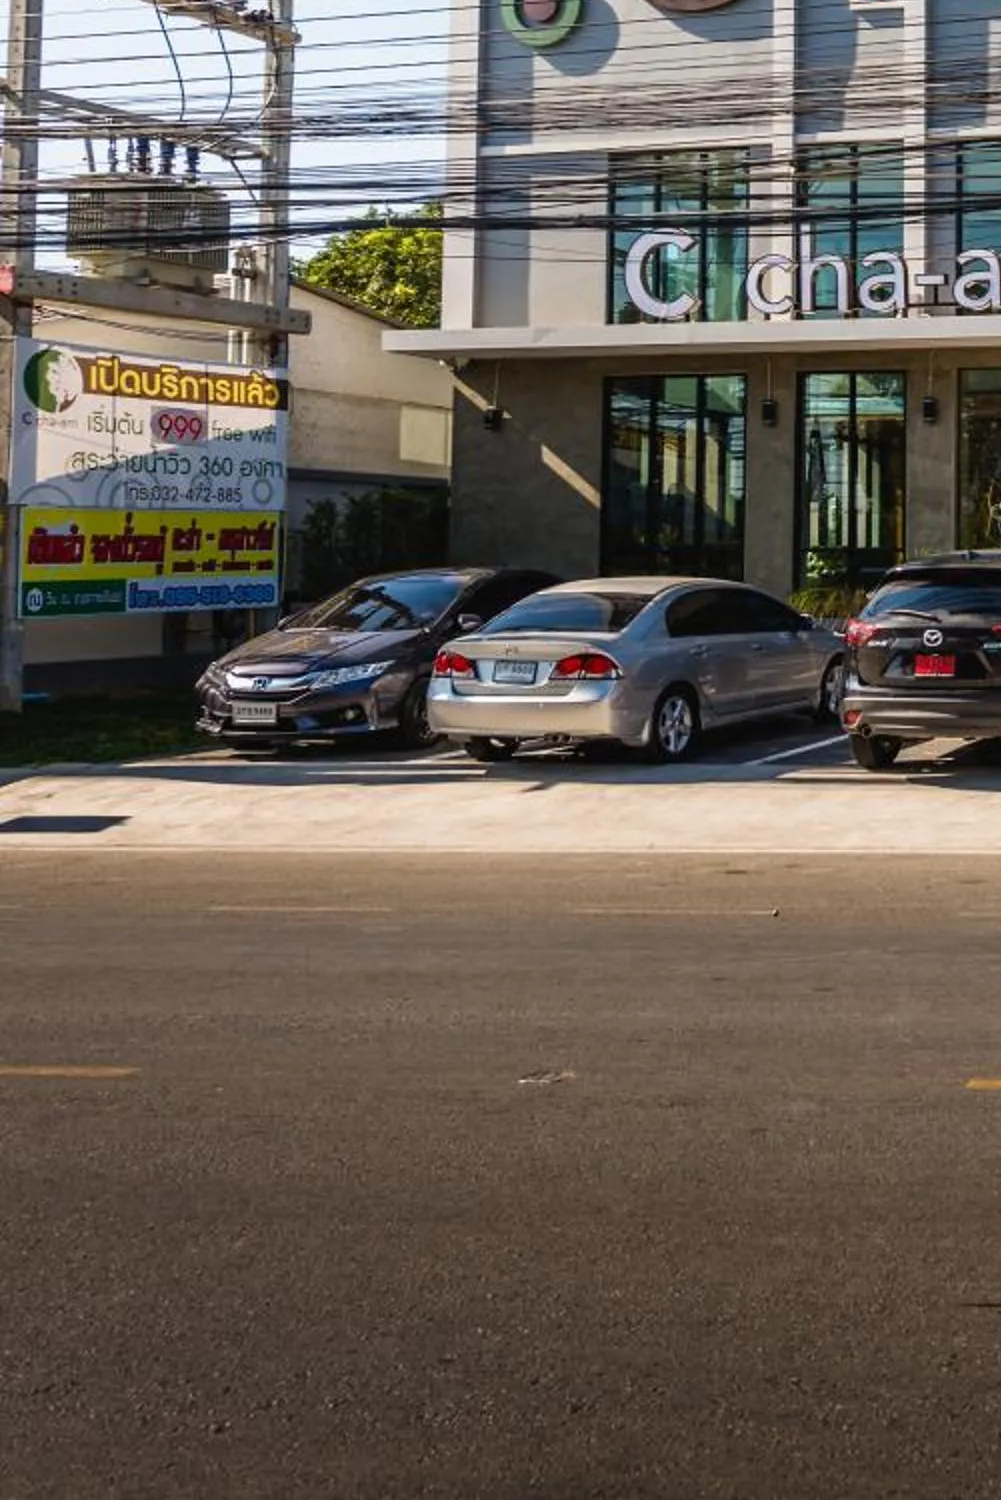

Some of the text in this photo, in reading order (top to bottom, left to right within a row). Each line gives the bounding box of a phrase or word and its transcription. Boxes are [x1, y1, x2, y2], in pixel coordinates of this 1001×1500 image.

[624, 227, 698, 319] C
[90, 357, 280, 406] เปิดบริการแล้ว
[159, 413, 203, 441] 999
[199, 455, 233, 477] 360
